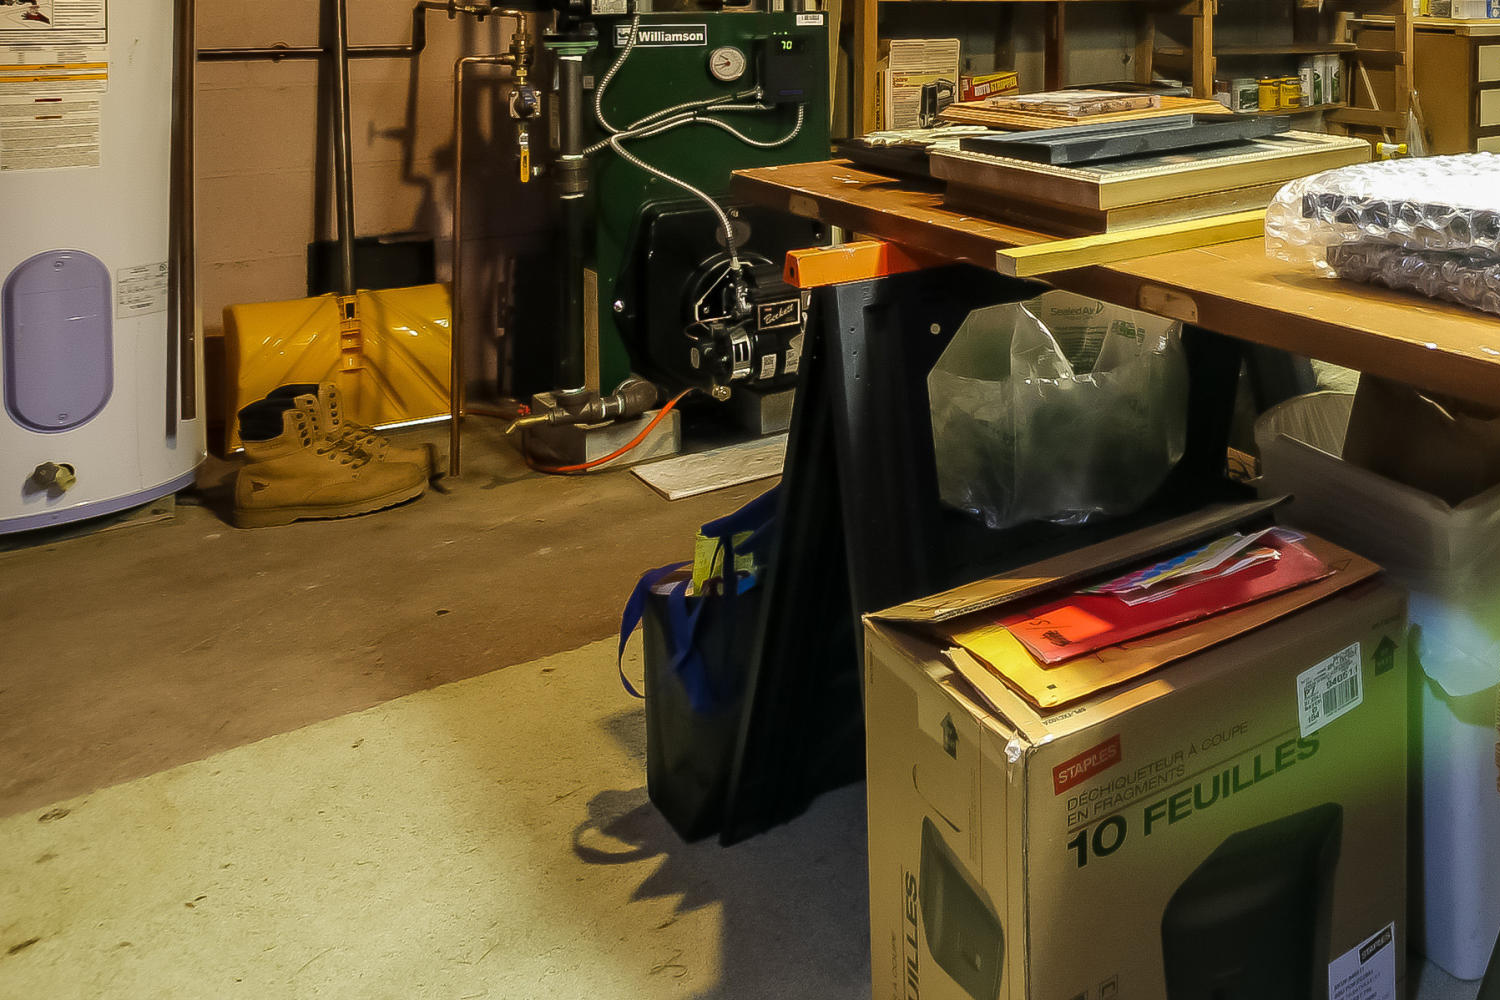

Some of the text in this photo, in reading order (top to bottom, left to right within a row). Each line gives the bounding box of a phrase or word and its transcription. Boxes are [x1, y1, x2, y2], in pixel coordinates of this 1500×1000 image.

[638, 30, 705, 43] Williamson
[780, 40, 793, 50] 70
[763, 303, 794, 325] Beckett
[1051, 306, 1082, 315] Sealed
[1058, 743, 1118, 785] STAPLES
[1067, 719, 1249, 812] DÉCHIQUETEUR À COUPÉ
[1067, 763, 1186, 828] EN FRAGMENTS
[1067, 731, 1321, 870] 10 FEUILLES
[905, 870, 920, 1000] UILLES
